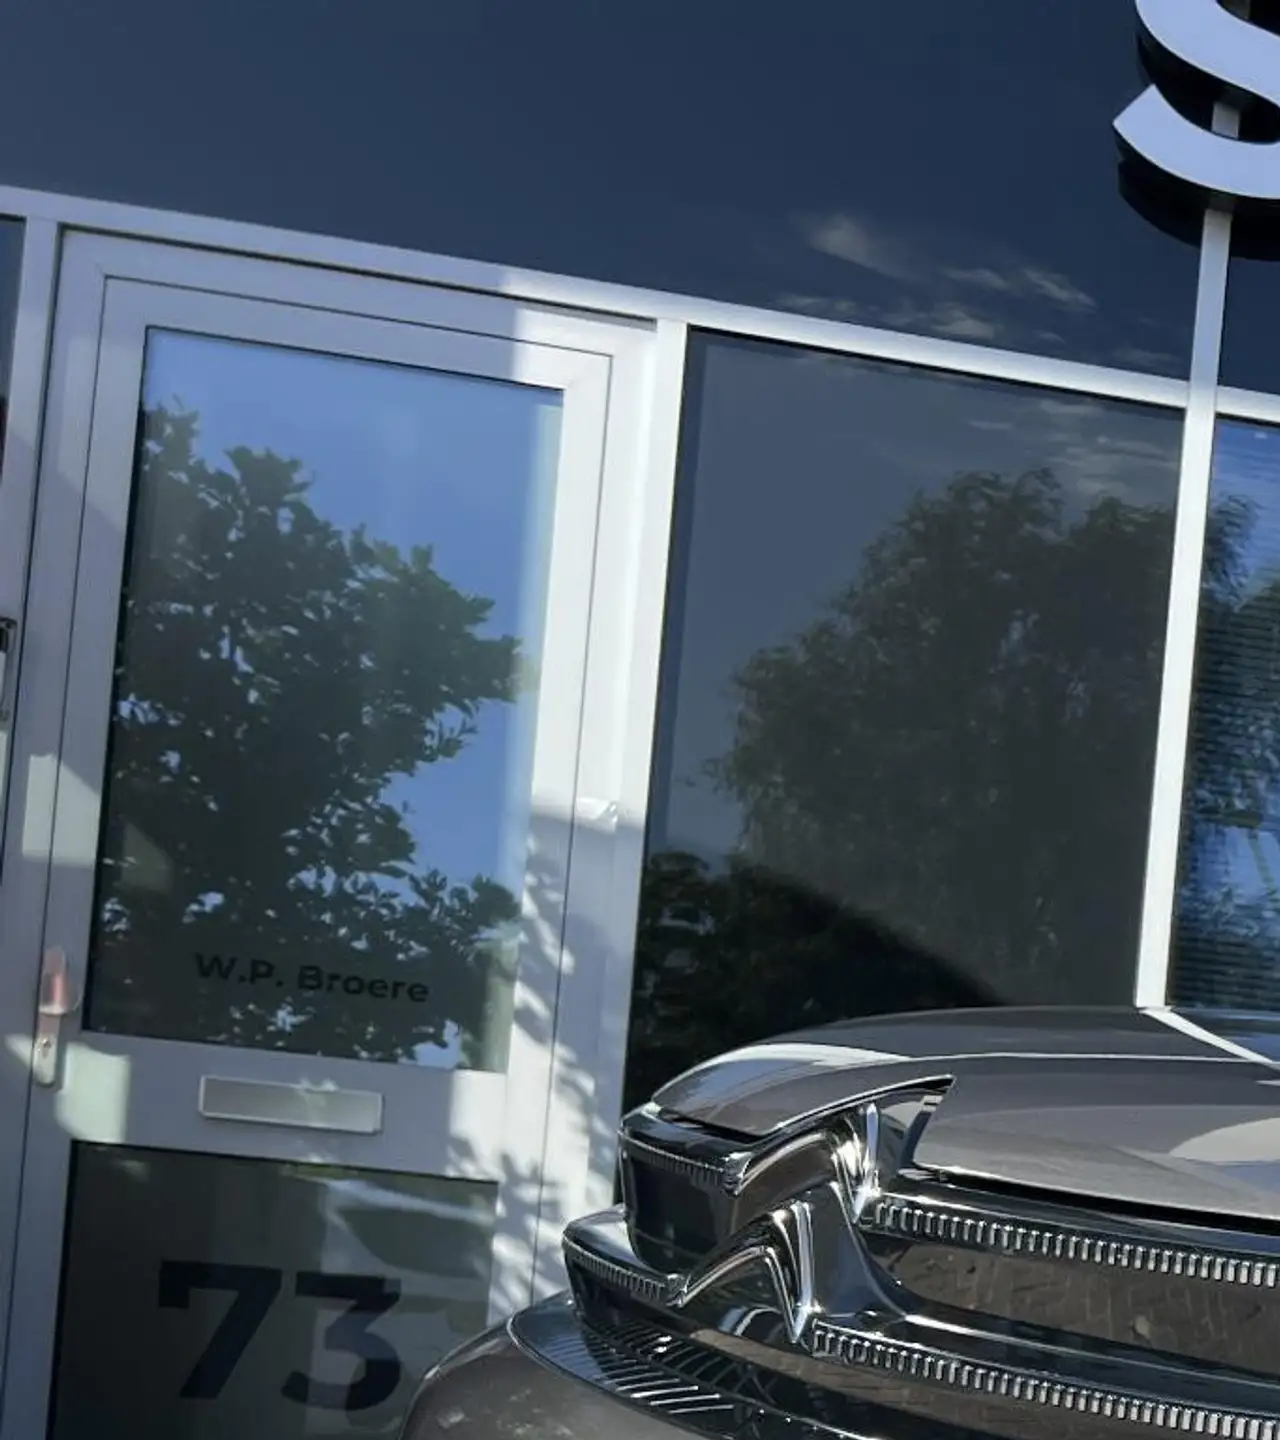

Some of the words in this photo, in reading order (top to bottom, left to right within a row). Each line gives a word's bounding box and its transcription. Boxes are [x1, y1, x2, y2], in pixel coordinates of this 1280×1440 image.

[196, 953, 284, 988] W.P.
[297, 965, 430, 1003] Broere
[158, 1259, 402, 1412] 73
